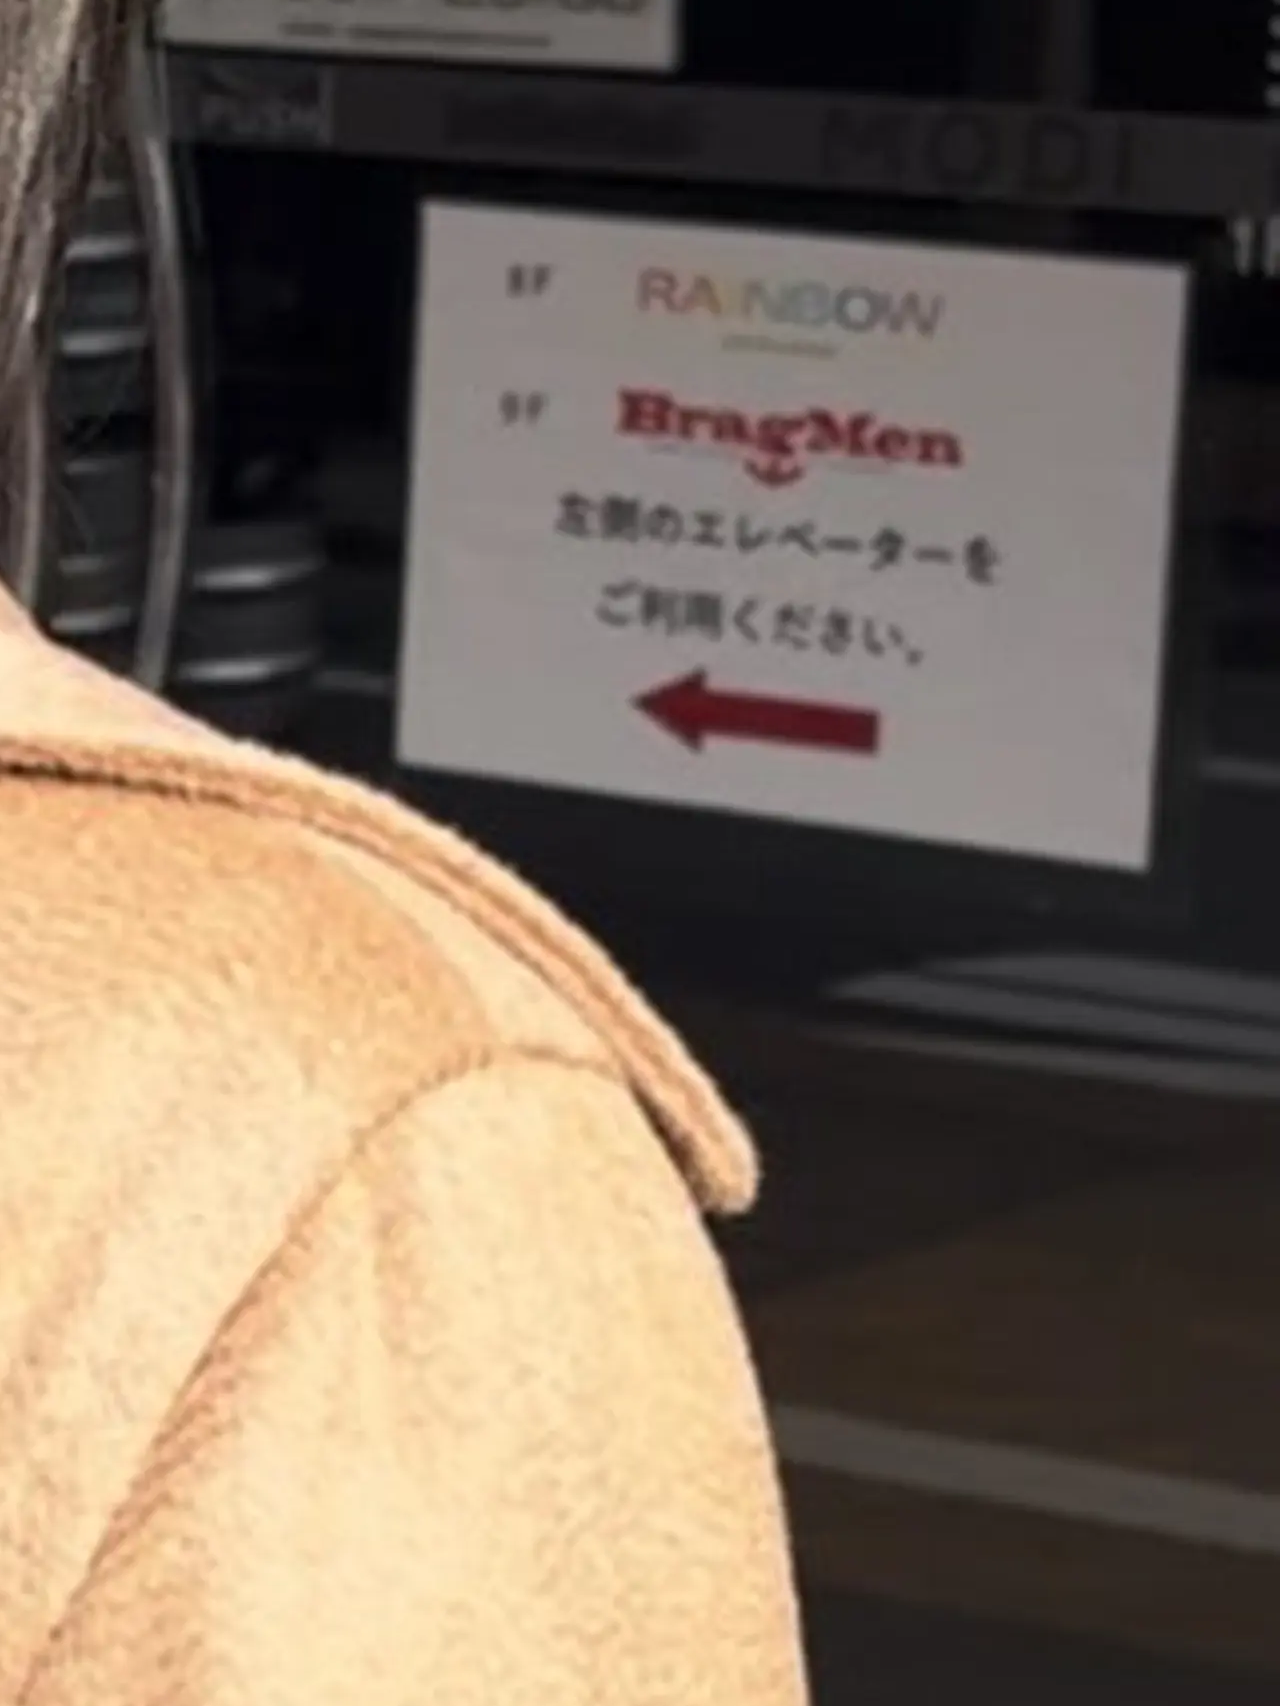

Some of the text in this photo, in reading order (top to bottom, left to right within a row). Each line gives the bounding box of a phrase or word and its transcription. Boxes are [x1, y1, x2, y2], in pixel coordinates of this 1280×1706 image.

[821, 106, 1134, 196] MODI
[615, 384, 965, 469] BragMen
[554, 492, 1000, 587] 左側のエレベーターを
[594, 580, 926, 667] ご利用ください。
